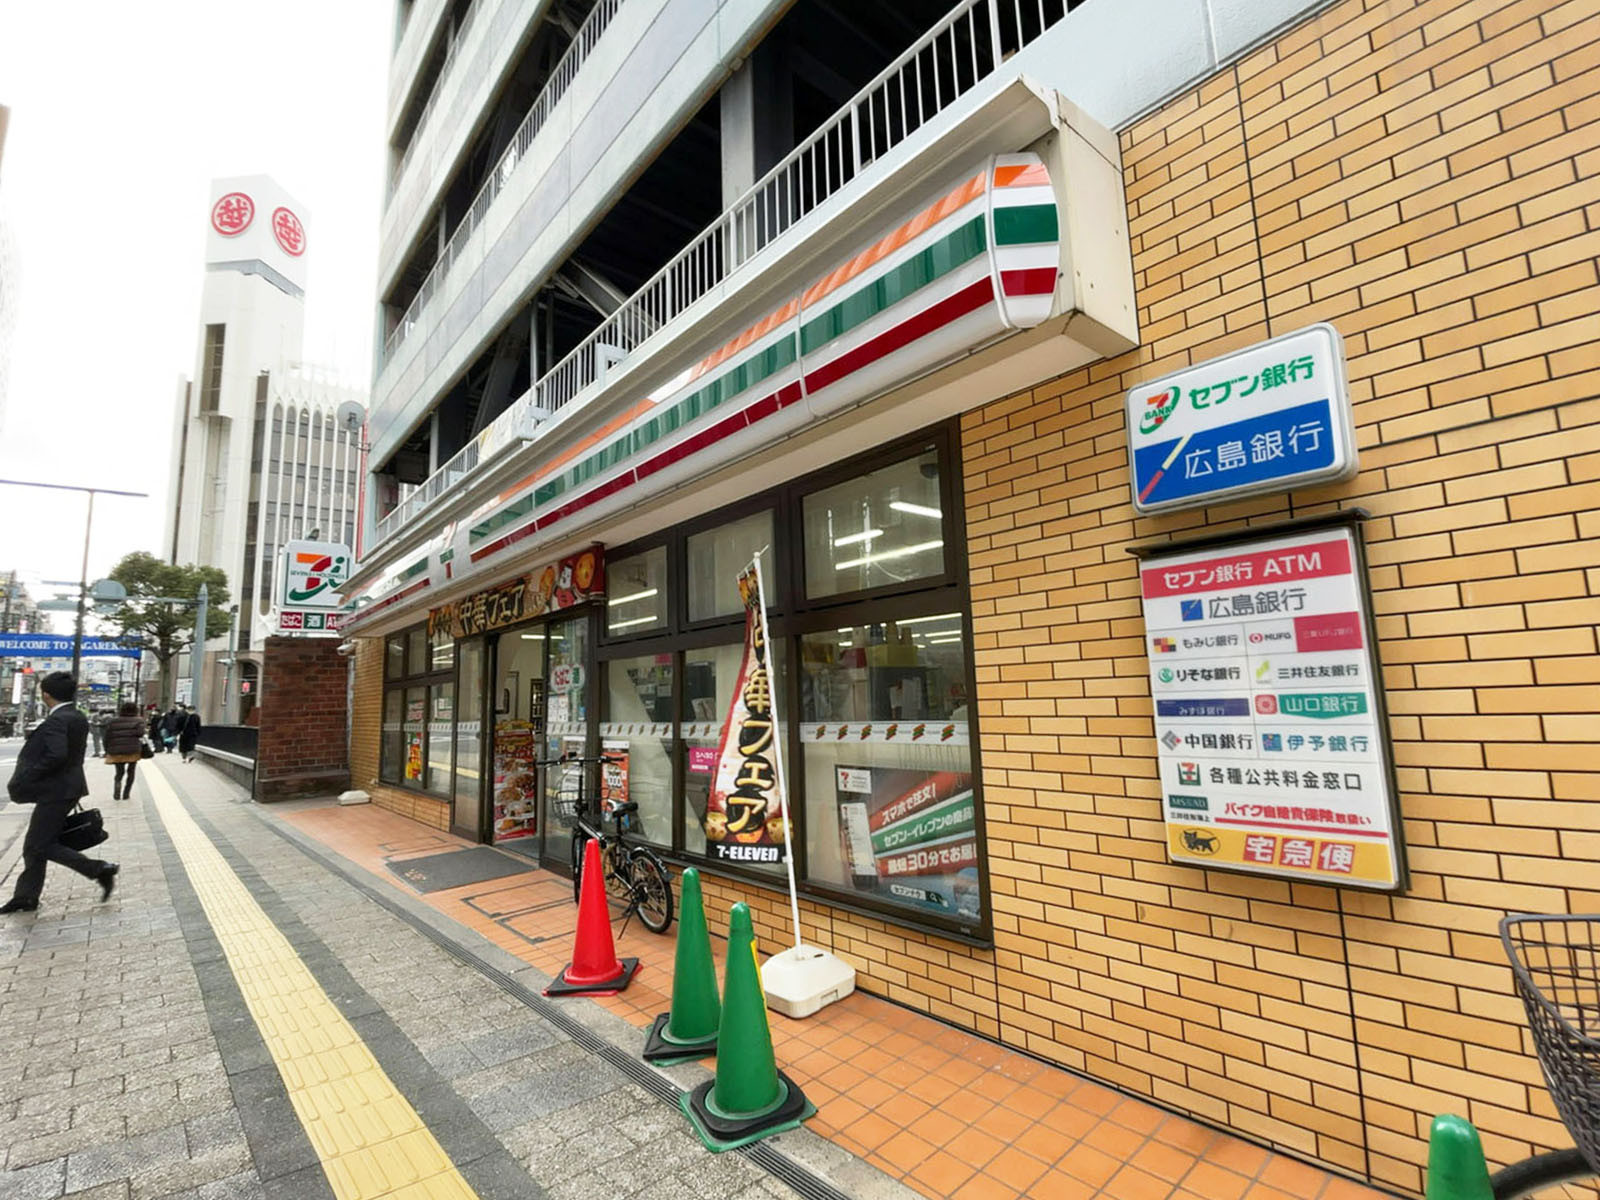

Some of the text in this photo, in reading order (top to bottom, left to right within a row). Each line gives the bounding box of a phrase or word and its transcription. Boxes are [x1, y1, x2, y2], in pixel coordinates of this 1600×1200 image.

[1188, 355, 1315, 410] セブン銀行
[1144, 406, 1174, 421] BANK
[1184, 420, 1325, 479] 広島銀行
[1164, 552, 1322, 590] セブン銀行 ATM
[459, 583, 526, 636] 中華フェア
[1208, 587, 1308, 620] 広島銀行
[307, 615, 321, 628] 酒
[0, 639, 51, 650] WELCOME
[54, 640, 69, 650] TO
[1183, 635, 1239, 649] もみじ銀行
[1264, 632, 1292, 641] MUFG
[1177, 666, 1241, 681] りそな銀行
[1277, 664, 1359, 679] 三井住友銀行
[1286, 695, 1360, 713] 山口銀行
[1185, 734, 1253, 750] 中国銀行
[1287, 734, 1369, 753] 伊予銀行
[1209, 766, 1363, 792] 各種公共料金窓口
[717, 845, 778, 862] 7-ELEVEN
[1245, 836, 1354, 872] 宅急便
